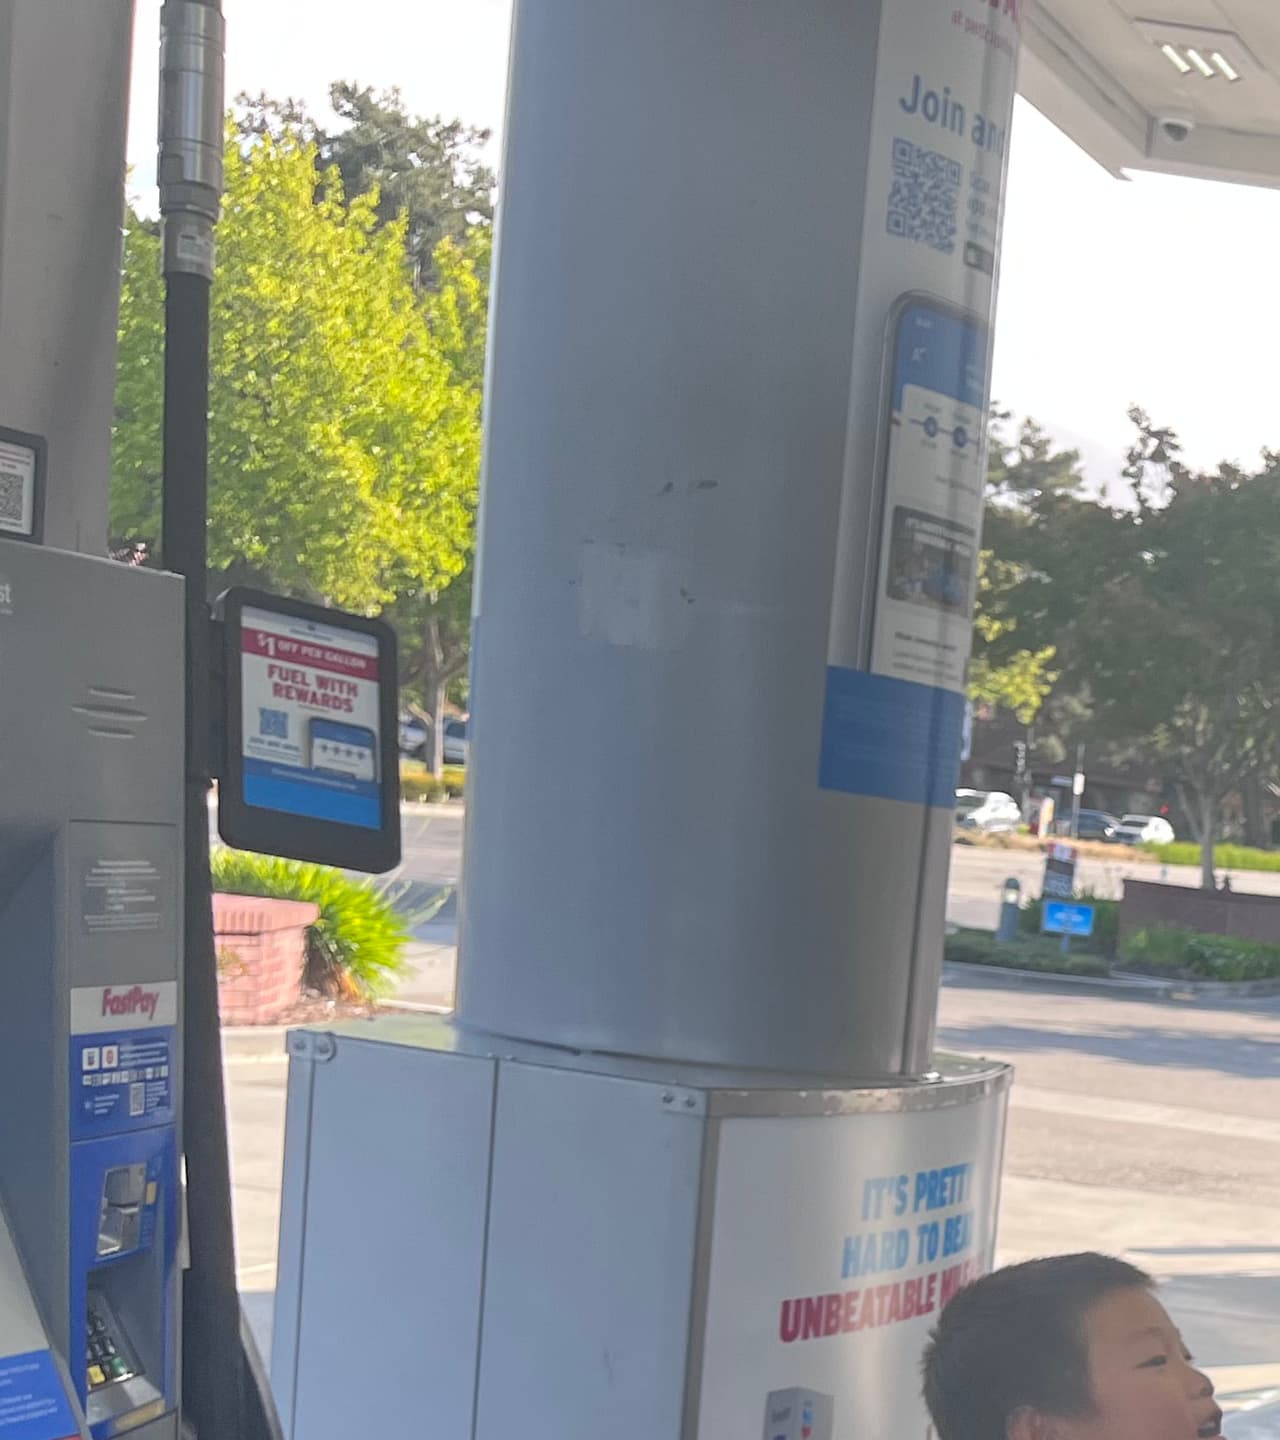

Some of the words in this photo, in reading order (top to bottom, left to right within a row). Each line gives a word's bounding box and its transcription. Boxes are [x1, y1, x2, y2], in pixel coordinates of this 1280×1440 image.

[899, 74, 965, 138] Join
[970, 112, 1005, 156] an
[256, 632, 276, 657] $1
[278, 639, 299, 655] OFF
[300, 644, 322, 660] PER
[323, 648, 367, 671] GALLON
[267, 663, 310, 687] FUEL
[315, 673, 359, 698] WITH
[272, 682, 354, 714] REWARDS
[102, 984, 160, 1020] FastPay
[861, 1173, 909, 1222] IT'S
[841, 1229, 910, 1280] HARD
[917, 1220, 940, 1265] TO
[779, 1271, 938, 1344] UNBEATABLE
